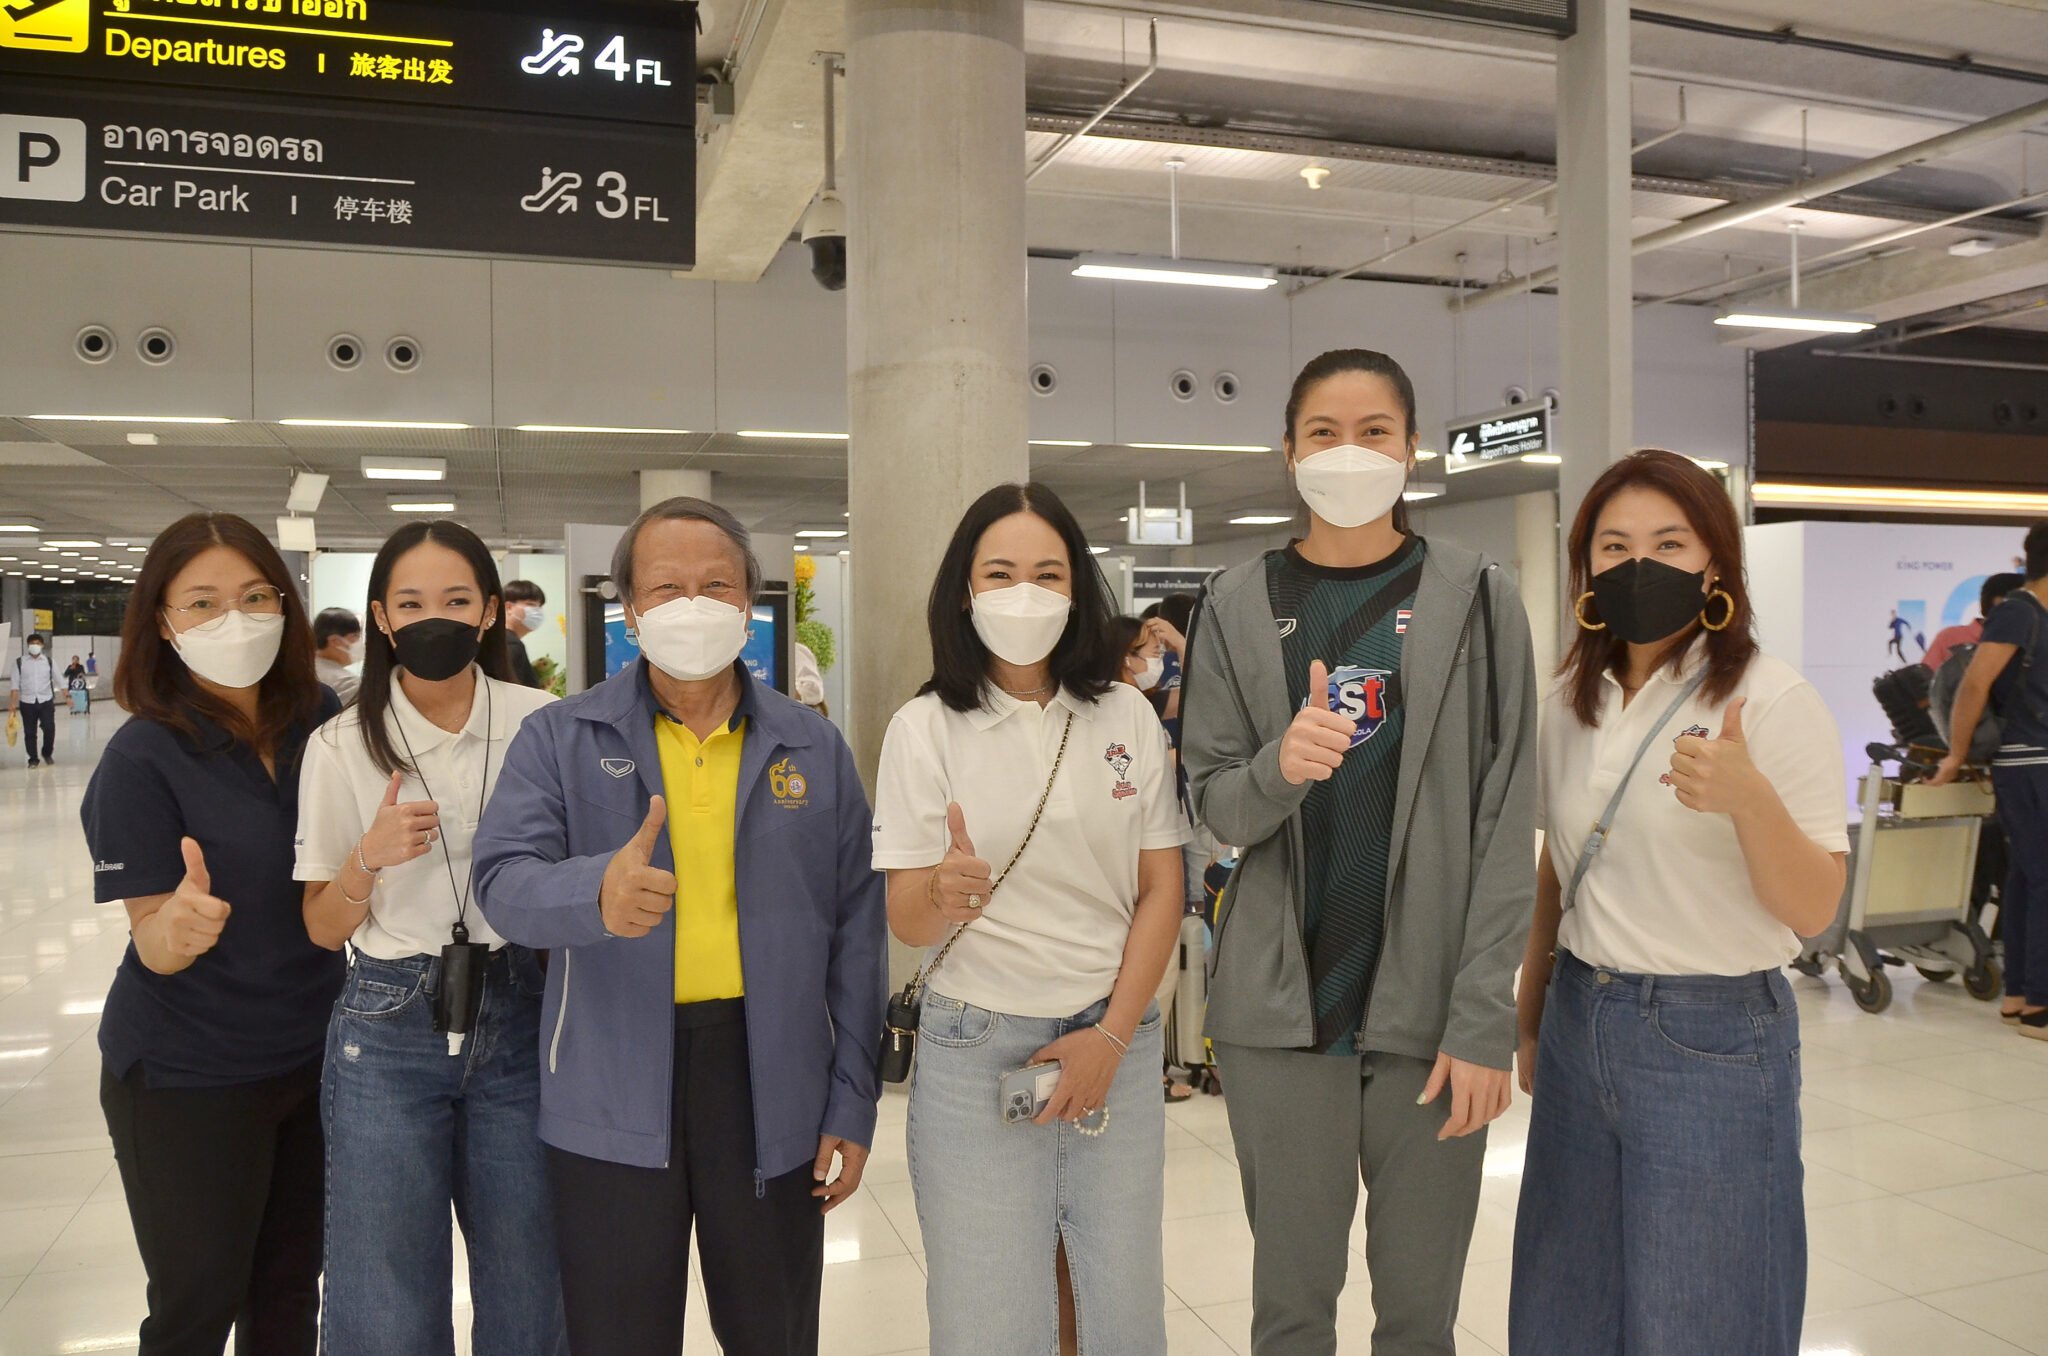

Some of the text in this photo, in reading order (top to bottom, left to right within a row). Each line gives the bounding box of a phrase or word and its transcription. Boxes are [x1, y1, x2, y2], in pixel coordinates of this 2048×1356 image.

[106, 28, 286, 70] Departures
[350, 52, 453, 84] 旅客出发
[595, 36, 671, 86] 4 FL
[19, 132, 60, 182] P
[103, 124, 323, 163] อาคารจอดรถ
[101, 177, 250, 212] Car Park
[334, 195, 413, 225] 停车楼
[596, 171, 669, 222] 3 FL
